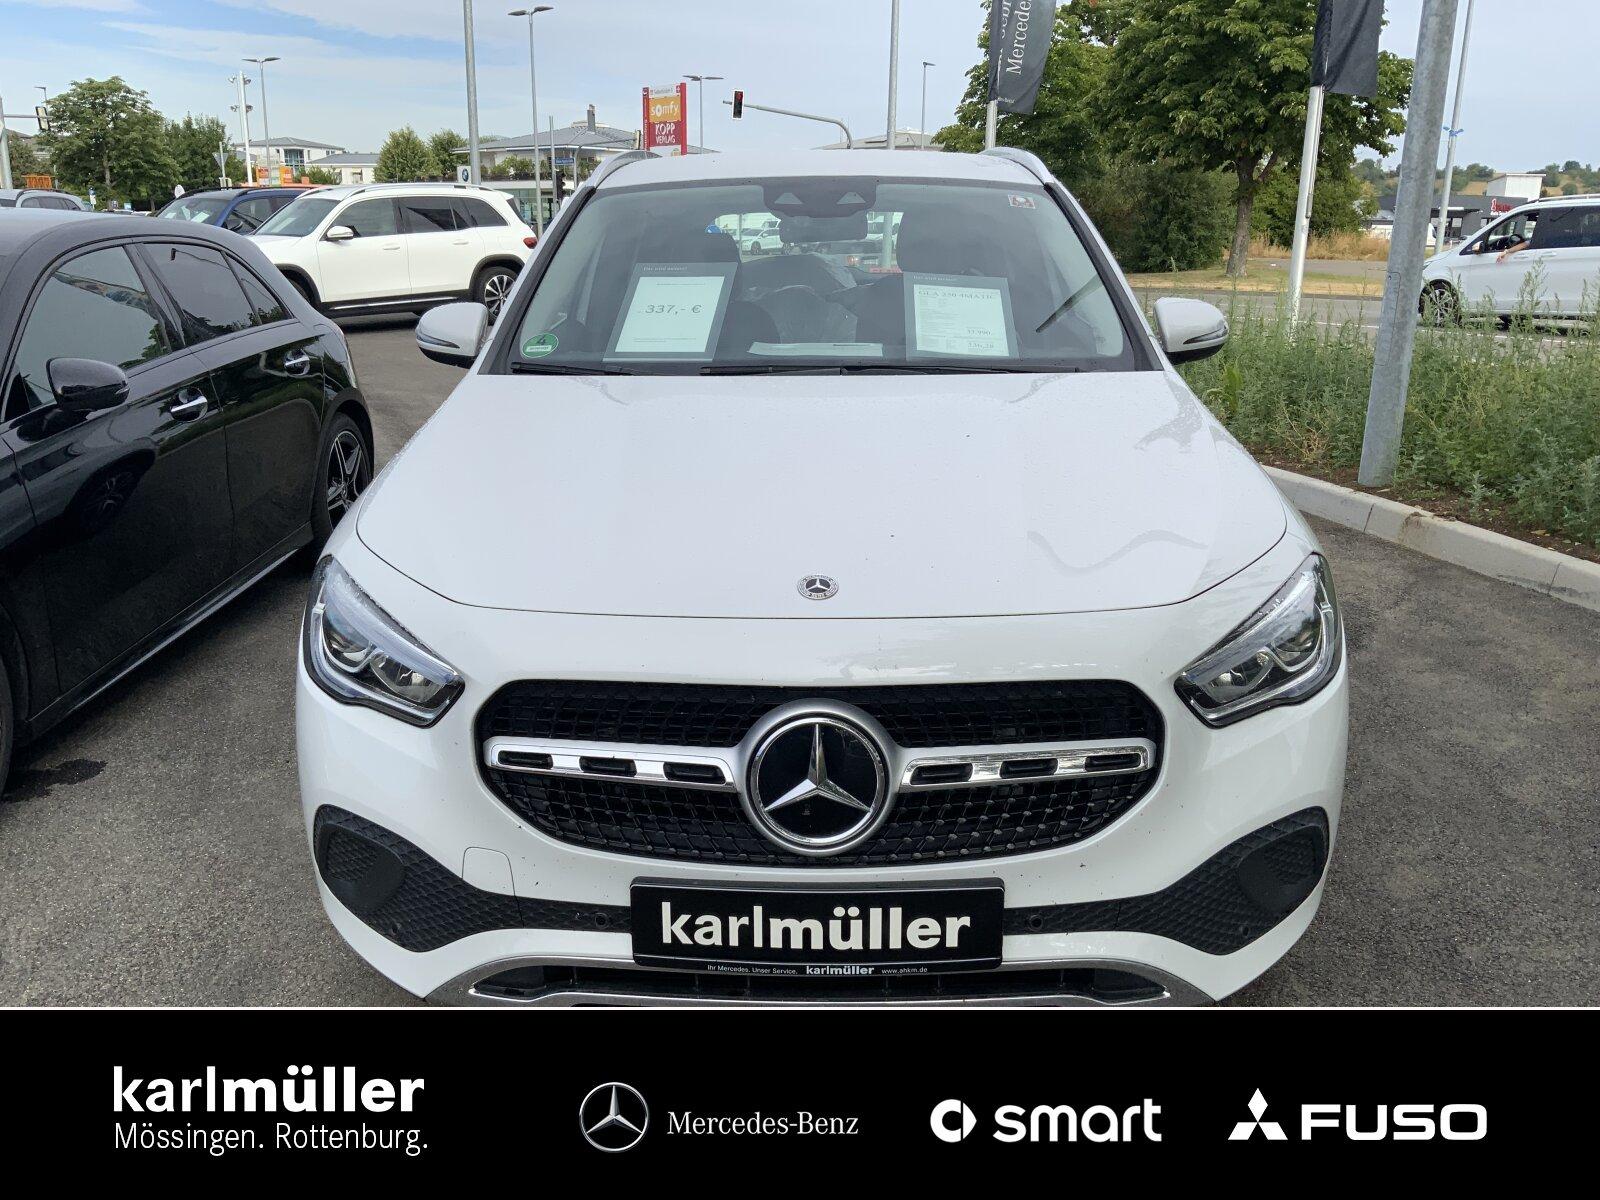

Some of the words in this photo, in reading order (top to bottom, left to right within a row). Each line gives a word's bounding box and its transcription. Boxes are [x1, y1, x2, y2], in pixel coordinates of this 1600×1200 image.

[1006, 0, 1032, 75] Mercede
[651, 101, 679, 117] somfy
[655, 122, 676, 135] KOPP
[692, 304, 702, 314] €
[661, 901, 971, 951] karlmüller
[717, 965, 751, 973] Mercedes.
[772, 967, 799, 975] Service.
[806, 965, 875, 975] karlmüller
